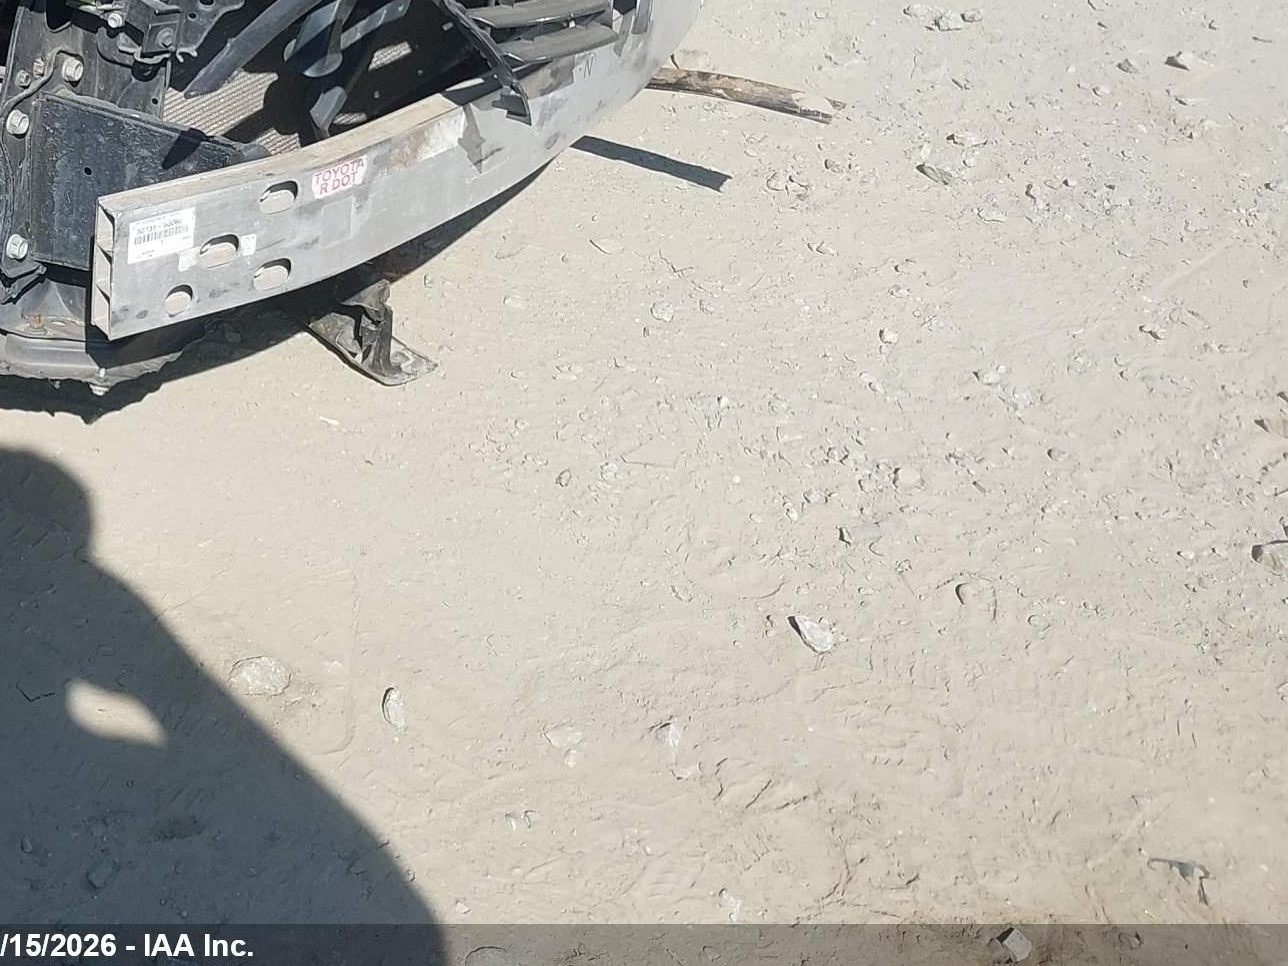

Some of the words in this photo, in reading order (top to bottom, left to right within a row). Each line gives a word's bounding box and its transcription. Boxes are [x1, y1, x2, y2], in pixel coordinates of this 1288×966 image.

[314, 158, 365, 185] TOYOTA
[319, 183, 328, 195] R
[331, 171, 358, 191] DOT
